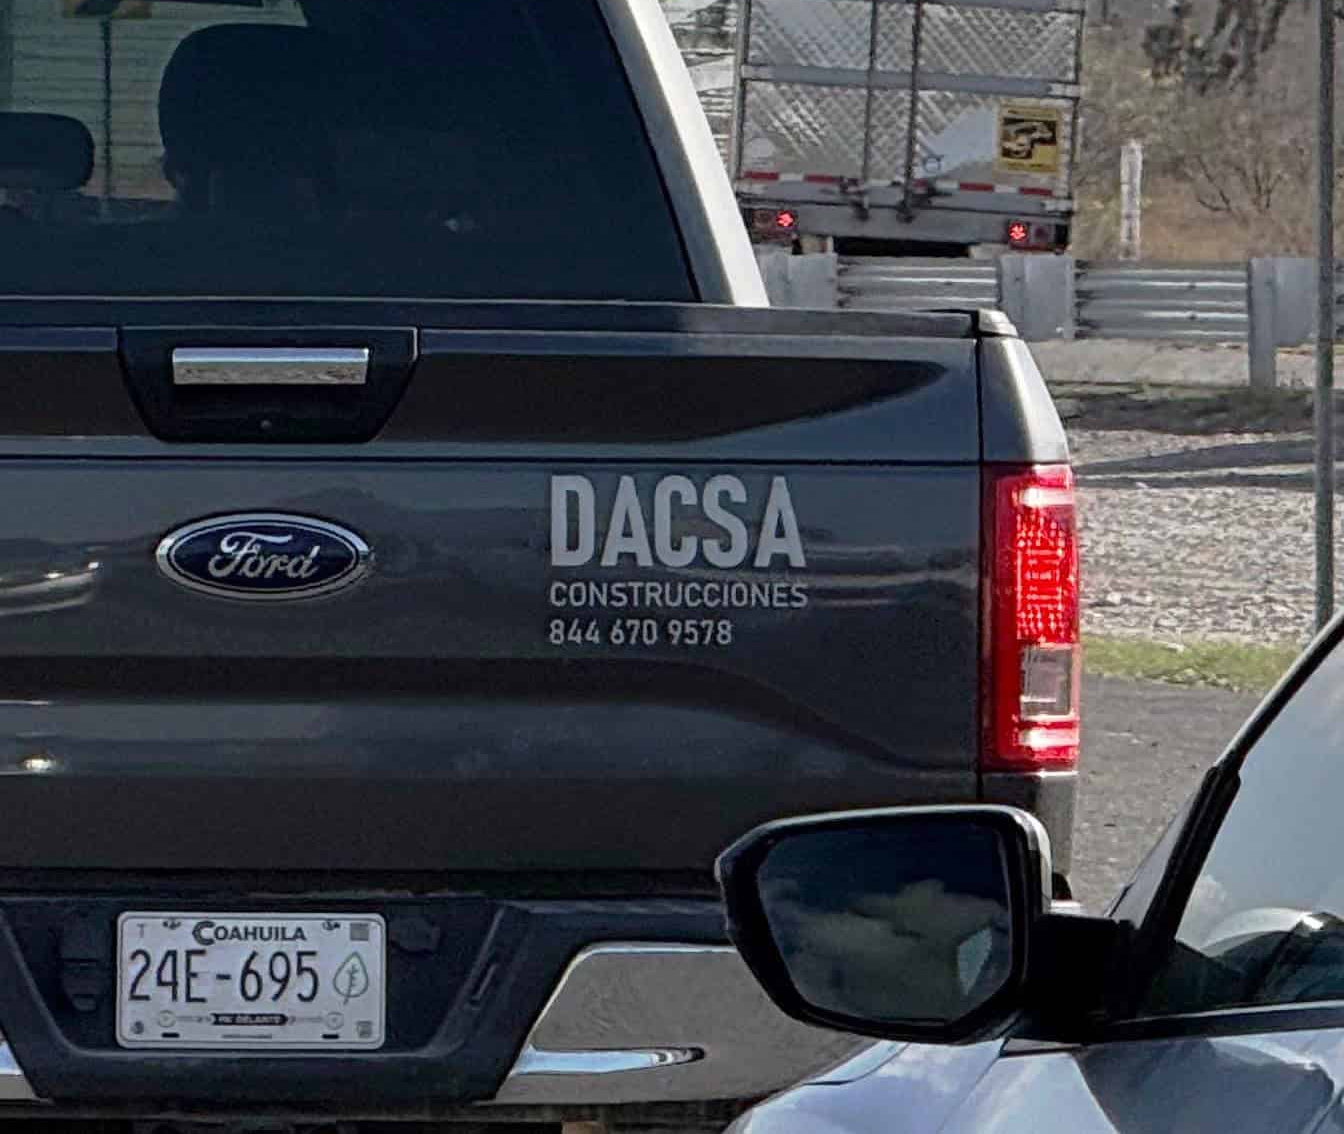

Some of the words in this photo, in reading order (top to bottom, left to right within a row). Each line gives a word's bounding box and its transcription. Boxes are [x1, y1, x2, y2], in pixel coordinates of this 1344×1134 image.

[551, 475, 807, 568] DACSA
[208, 531, 320, 578] Ford
[549, 581, 809, 608] CONSTRUCCIONES
[549, 619, 600, 645] 844
[611, 619, 658, 645] 670
[667, 619, 733, 645] 9578
[128, 948, 320, 1004] 24E-695
